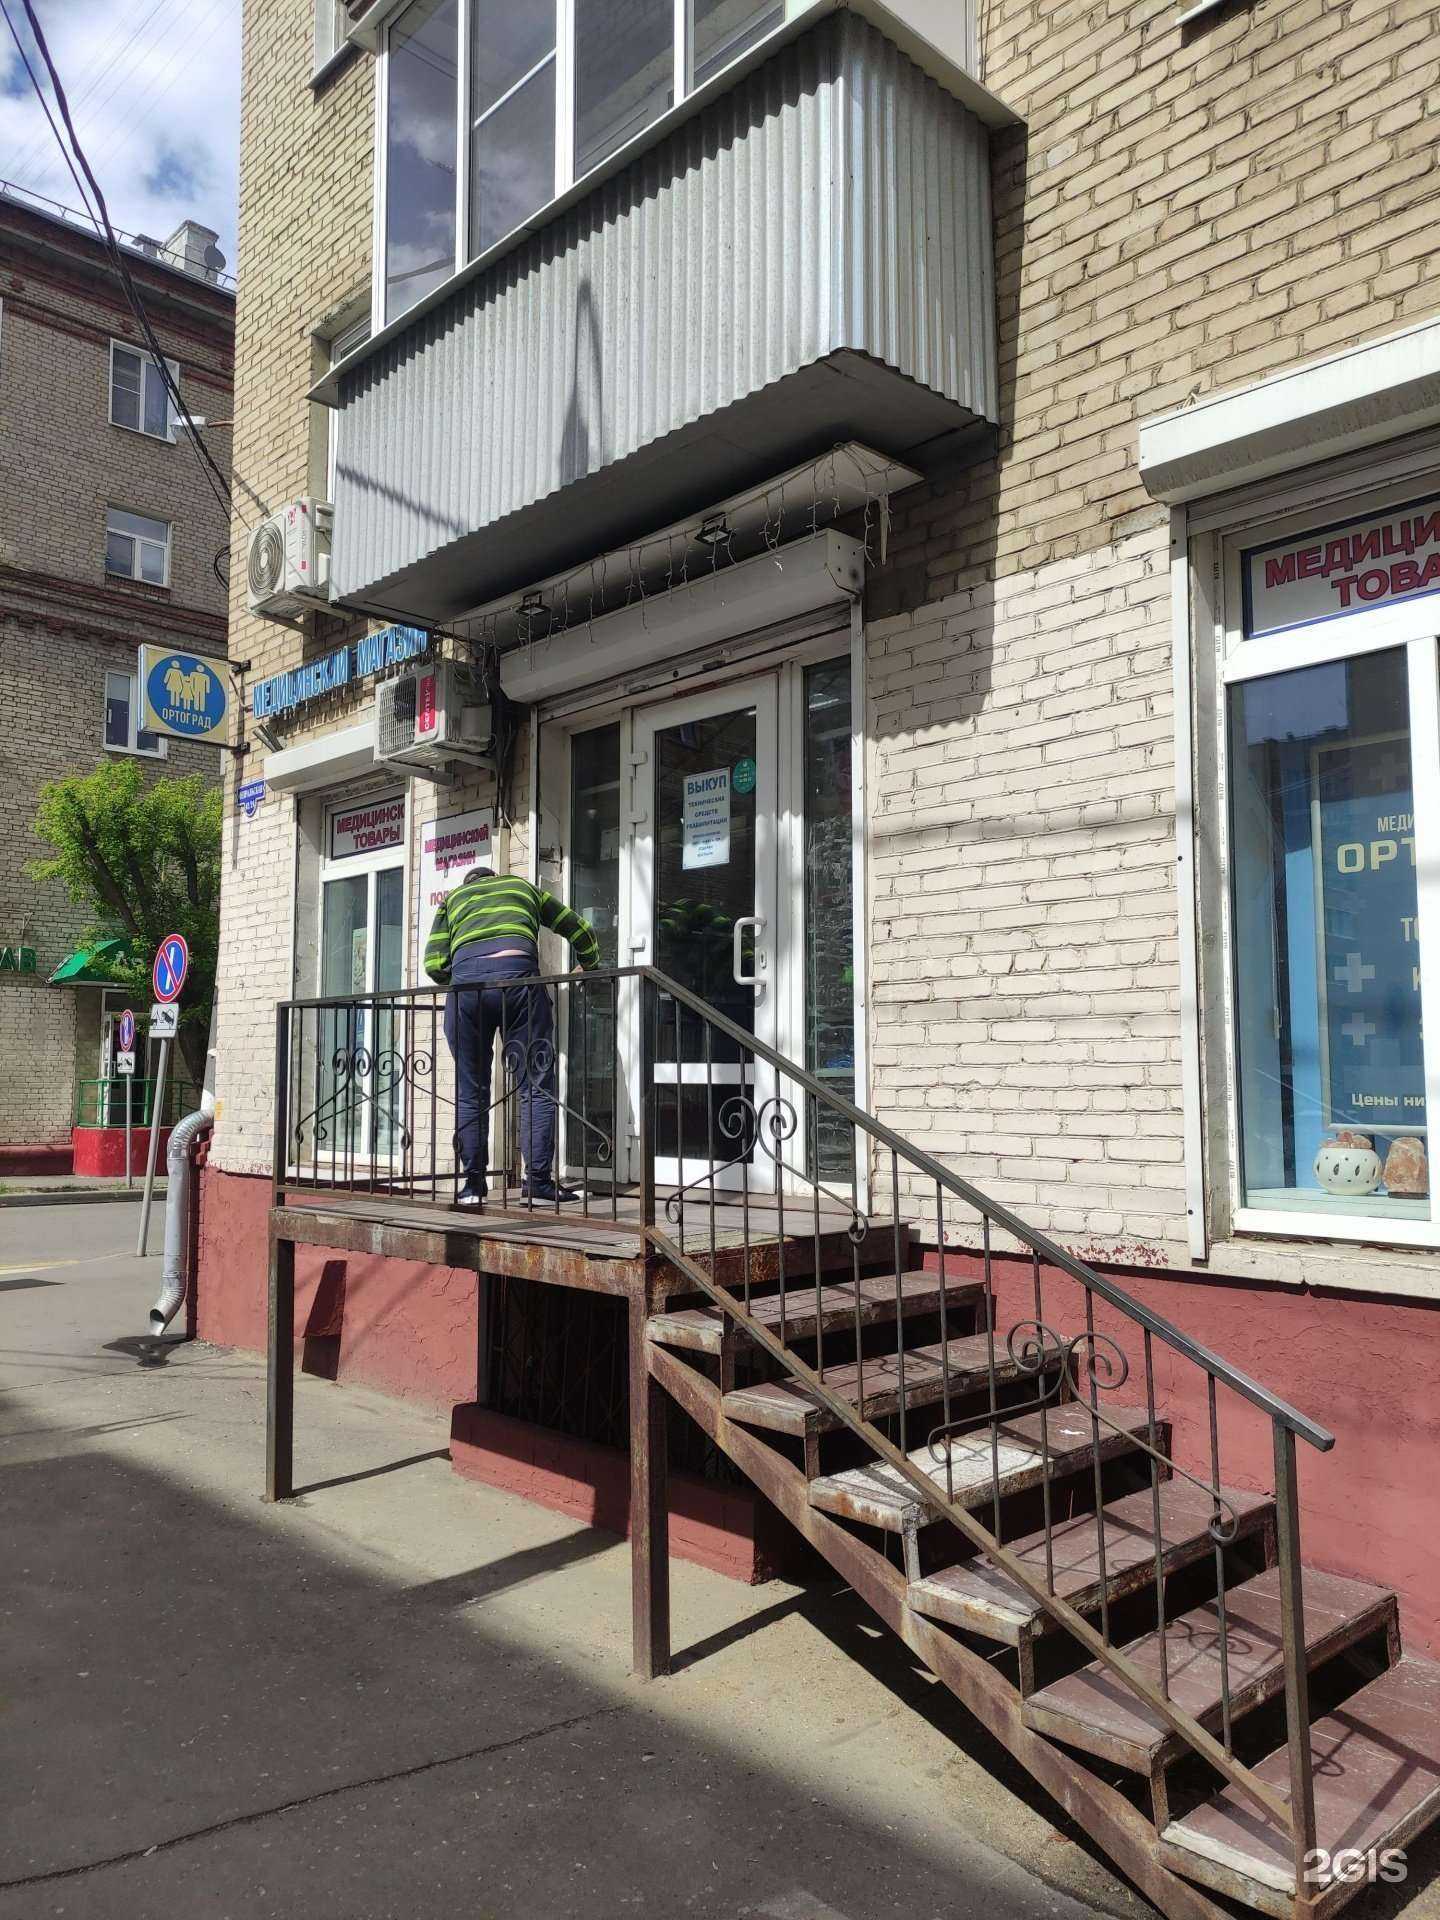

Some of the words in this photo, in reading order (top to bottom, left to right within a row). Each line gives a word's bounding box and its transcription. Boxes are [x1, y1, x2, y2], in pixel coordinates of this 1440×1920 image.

[1265, 510, 1440, 588] МЕДИЦИ
[162, 707, 212, 730] ОРТОГРАД
[687, 774, 727, 795] ВЫКУП
[336, 803, 405, 834] МЕДИЦИНСК
[353, 824, 401, 849] ТОВАРЫ
[425, 824, 489, 853] МЕДИЦИНСКИЙ
[1351, 1093, 1399, 1108] Цены
[1404, 1096, 1425, 1107] ни
